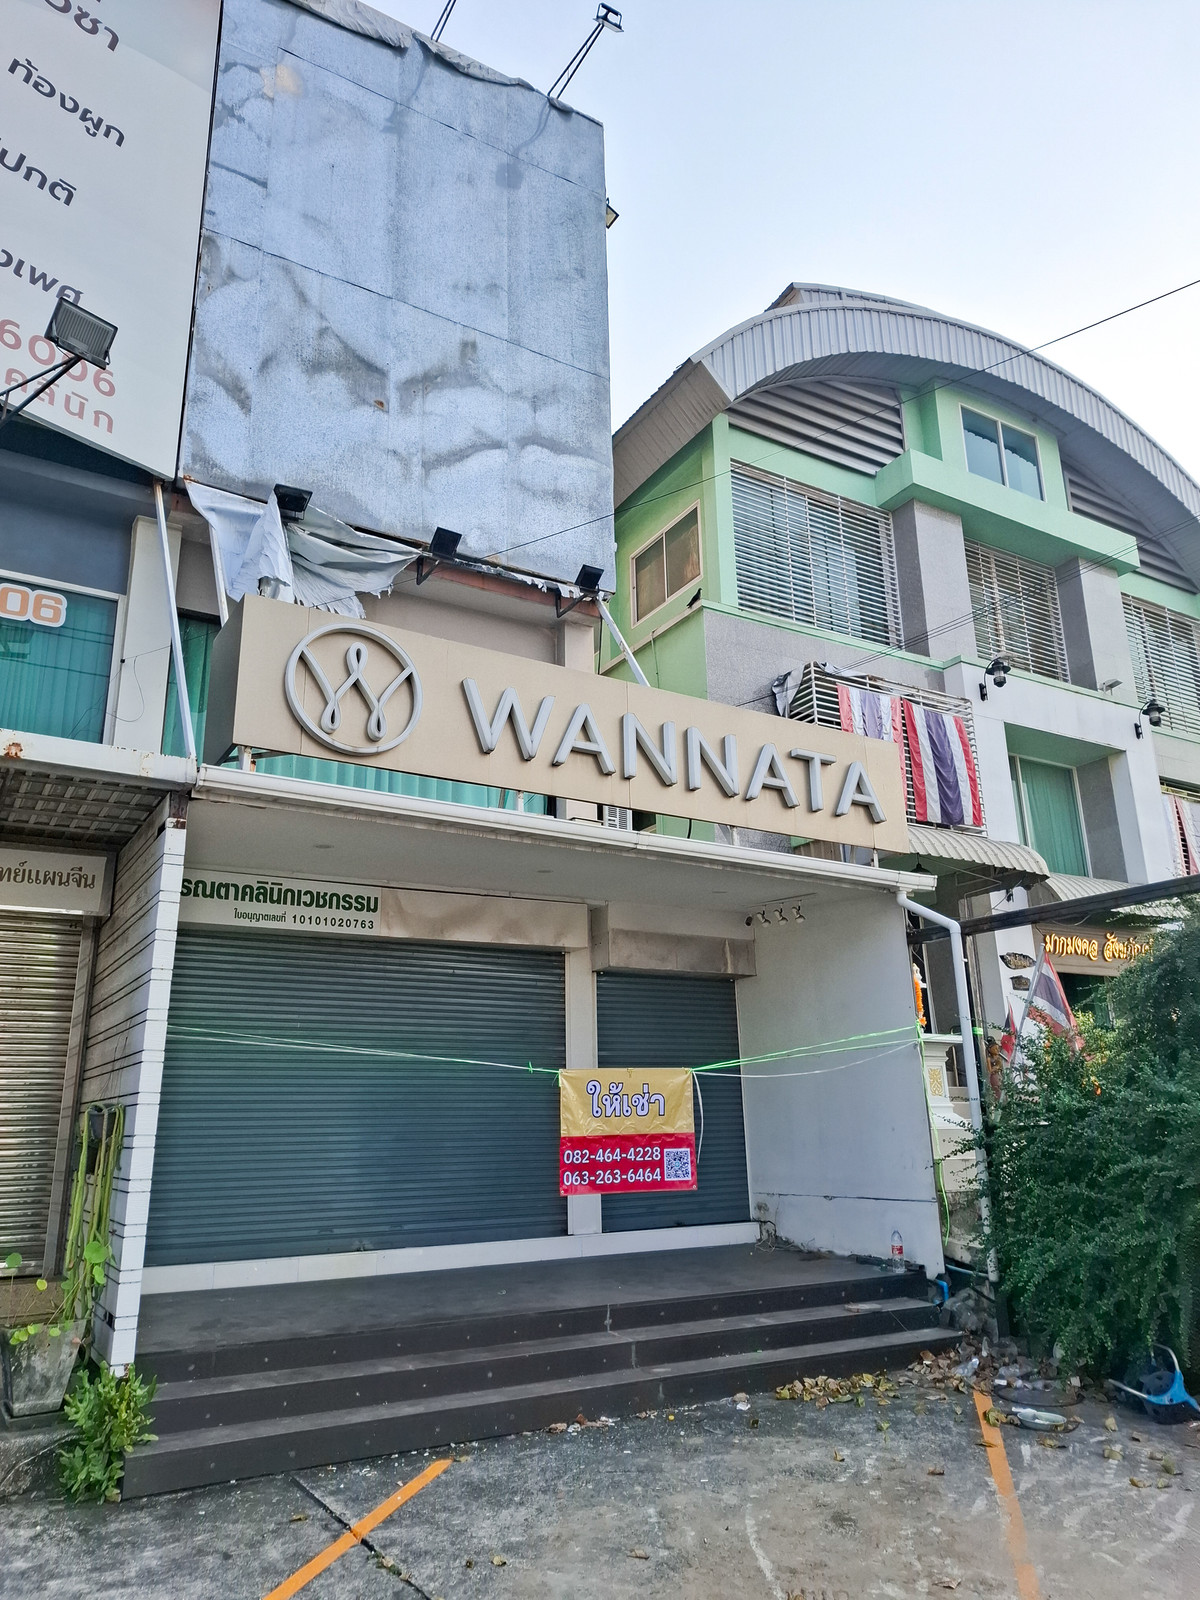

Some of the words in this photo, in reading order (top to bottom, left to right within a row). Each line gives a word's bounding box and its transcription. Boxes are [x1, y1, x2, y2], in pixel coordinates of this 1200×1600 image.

[7, 57, 125, 148] ท้องผูก
[462, 677, 886, 824] WANNATA
[292, 914, 375, 930] 10101020763
[586, 1079, 666, 1118] ให้เช่า
[563, 1146, 662, 1165] 082-464-4228
[563, 1167, 662, 1186] 063-263-6464
